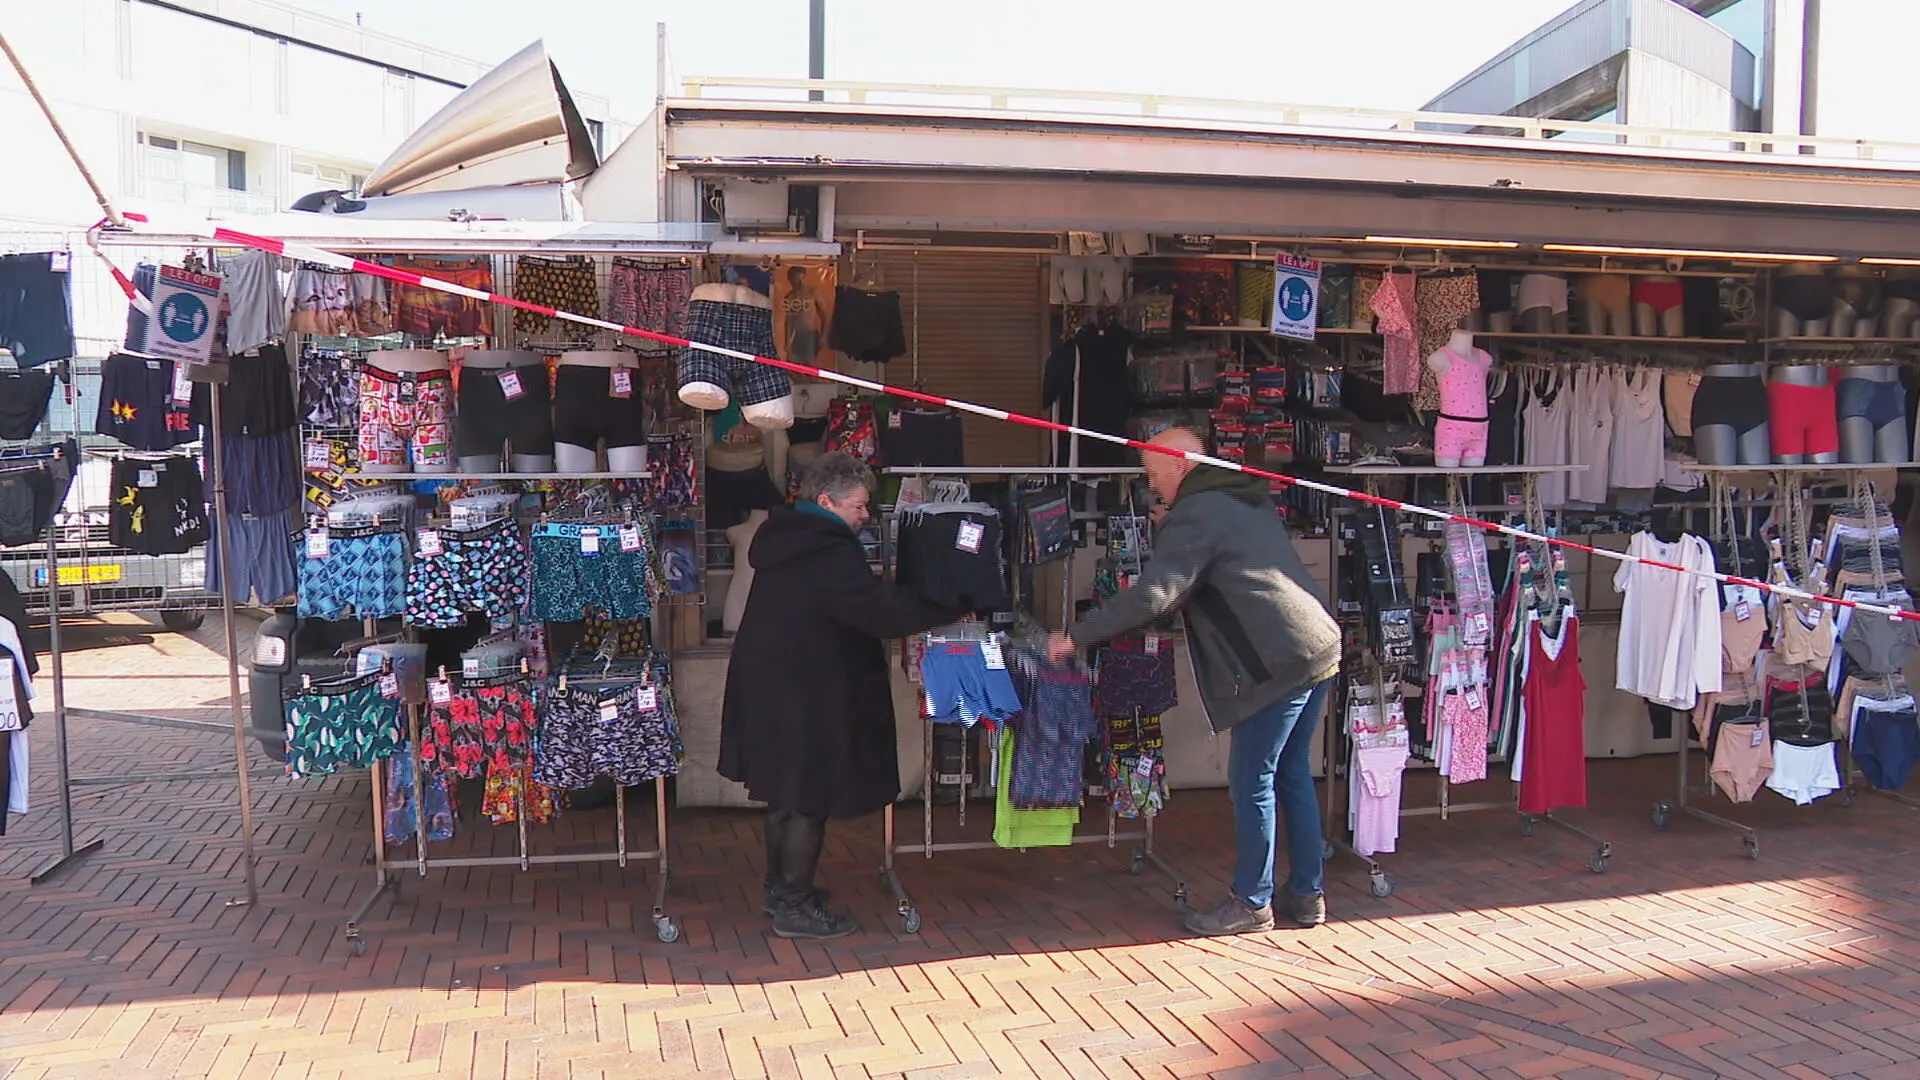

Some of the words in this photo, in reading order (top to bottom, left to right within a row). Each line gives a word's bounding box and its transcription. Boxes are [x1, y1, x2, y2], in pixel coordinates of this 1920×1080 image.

[169, 266, 191, 280] LET
[350, 527, 374, 538] J&C
[461, 679, 486, 687] J&C
[572, 690, 598, 705] MAN
